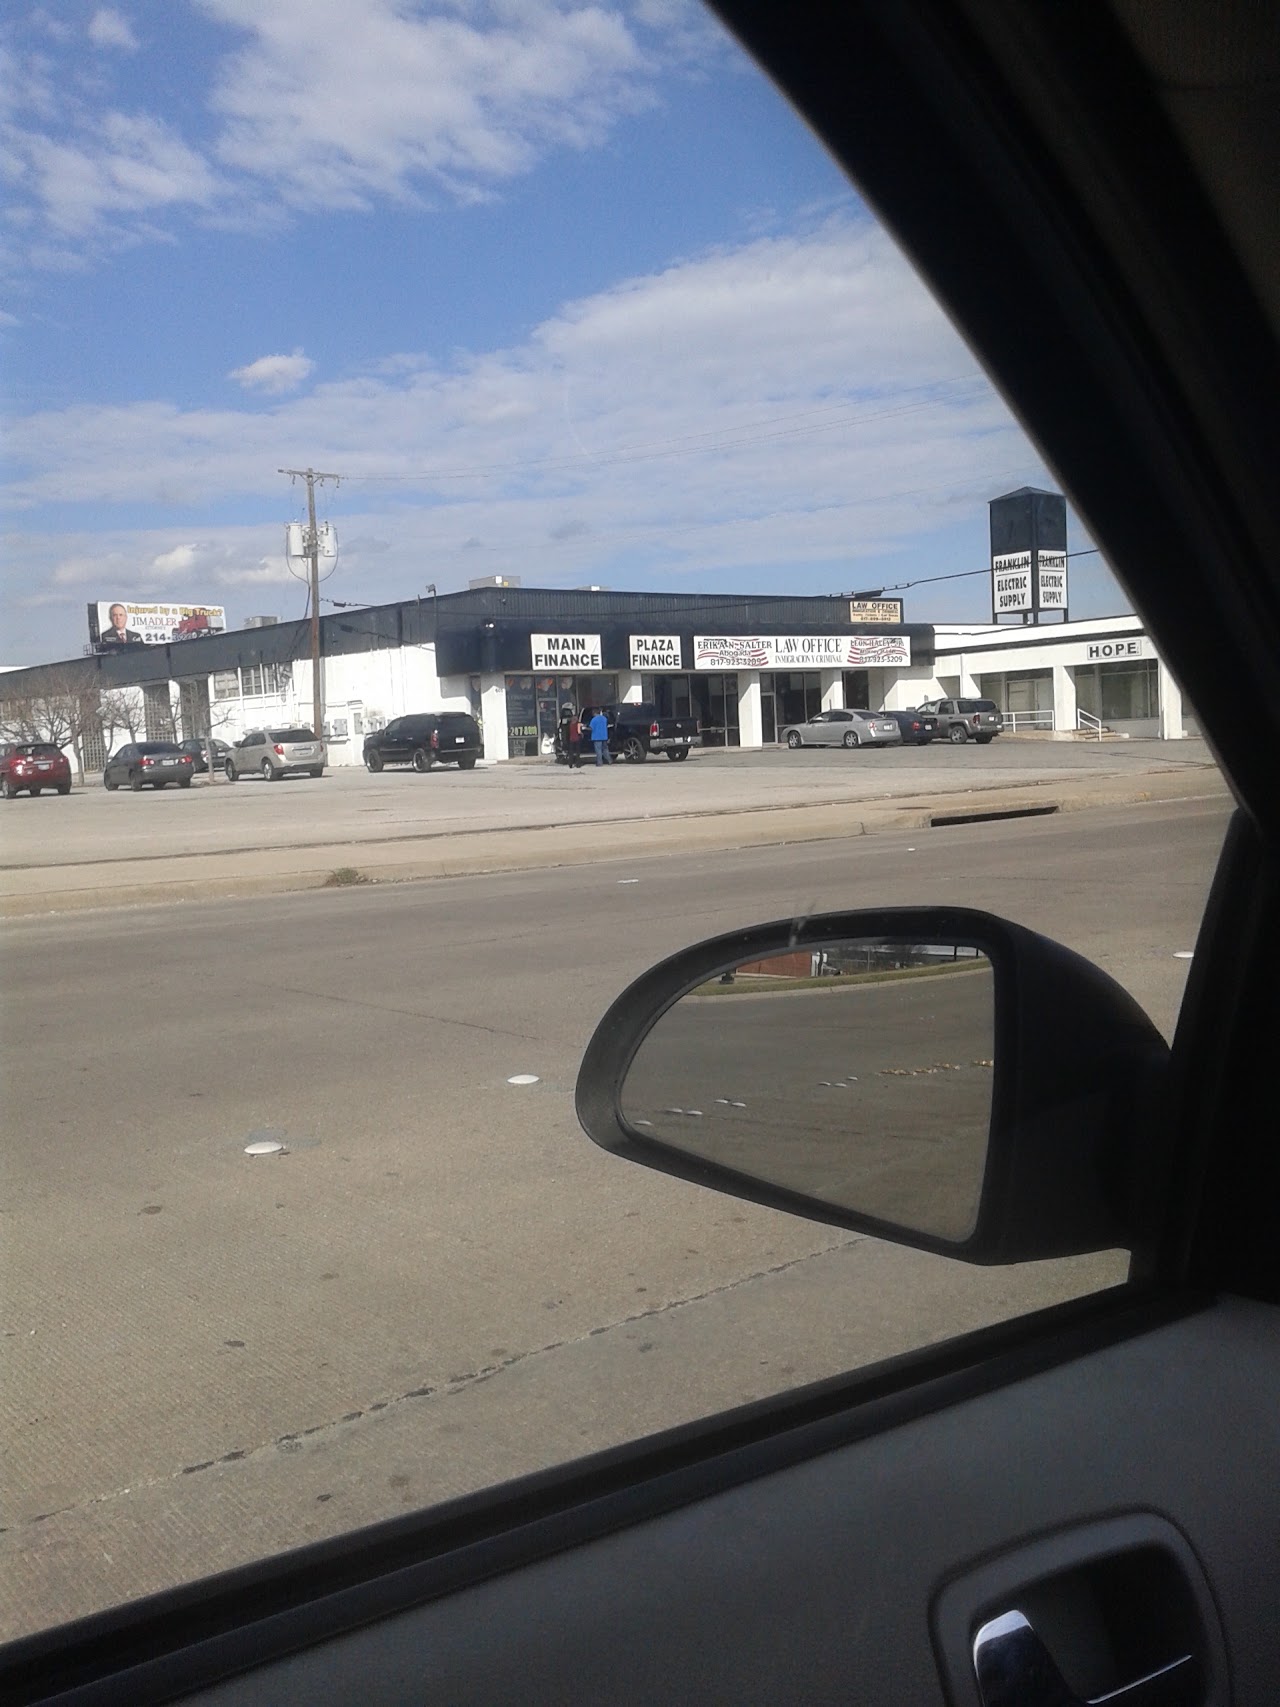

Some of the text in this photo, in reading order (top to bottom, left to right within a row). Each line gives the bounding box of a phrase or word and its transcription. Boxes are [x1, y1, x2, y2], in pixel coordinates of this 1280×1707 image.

[995, 556, 1029, 573] FRANKLIN
[1039, 555, 1065, 568] FRANKLIN
[997, 576, 1027, 592] ELECTRIC
[1040, 575, 1063, 588] ELECTRIC
[999, 593, 1026, 608] SUPPLY
[1042, 591, 1062, 603] SUPPLY
[127, 605, 158, 616] Injured
[159, 606, 171, 616] by
[172, 607, 179, 615] a
[179, 606, 194, 617] Big
[871, 602, 899, 610] OFFICE
[131, 617, 178, 627] JIM ADLER
[547, 638, 586, 651] MAIN
[636, 639, 674, 651] PLAZA
[697, 640, 726, 650] ERIKA
[739, 641, 773, 649] SALTER
[775, 638, 843, 653] LAW OFFICE
[1089, 642, 1137, 658] HOPE
[534, 654, 600, 666] FINANCE
[632, 654, 680, 666] FINANCE
[816, 655, 843, 663] CRIMINAL
